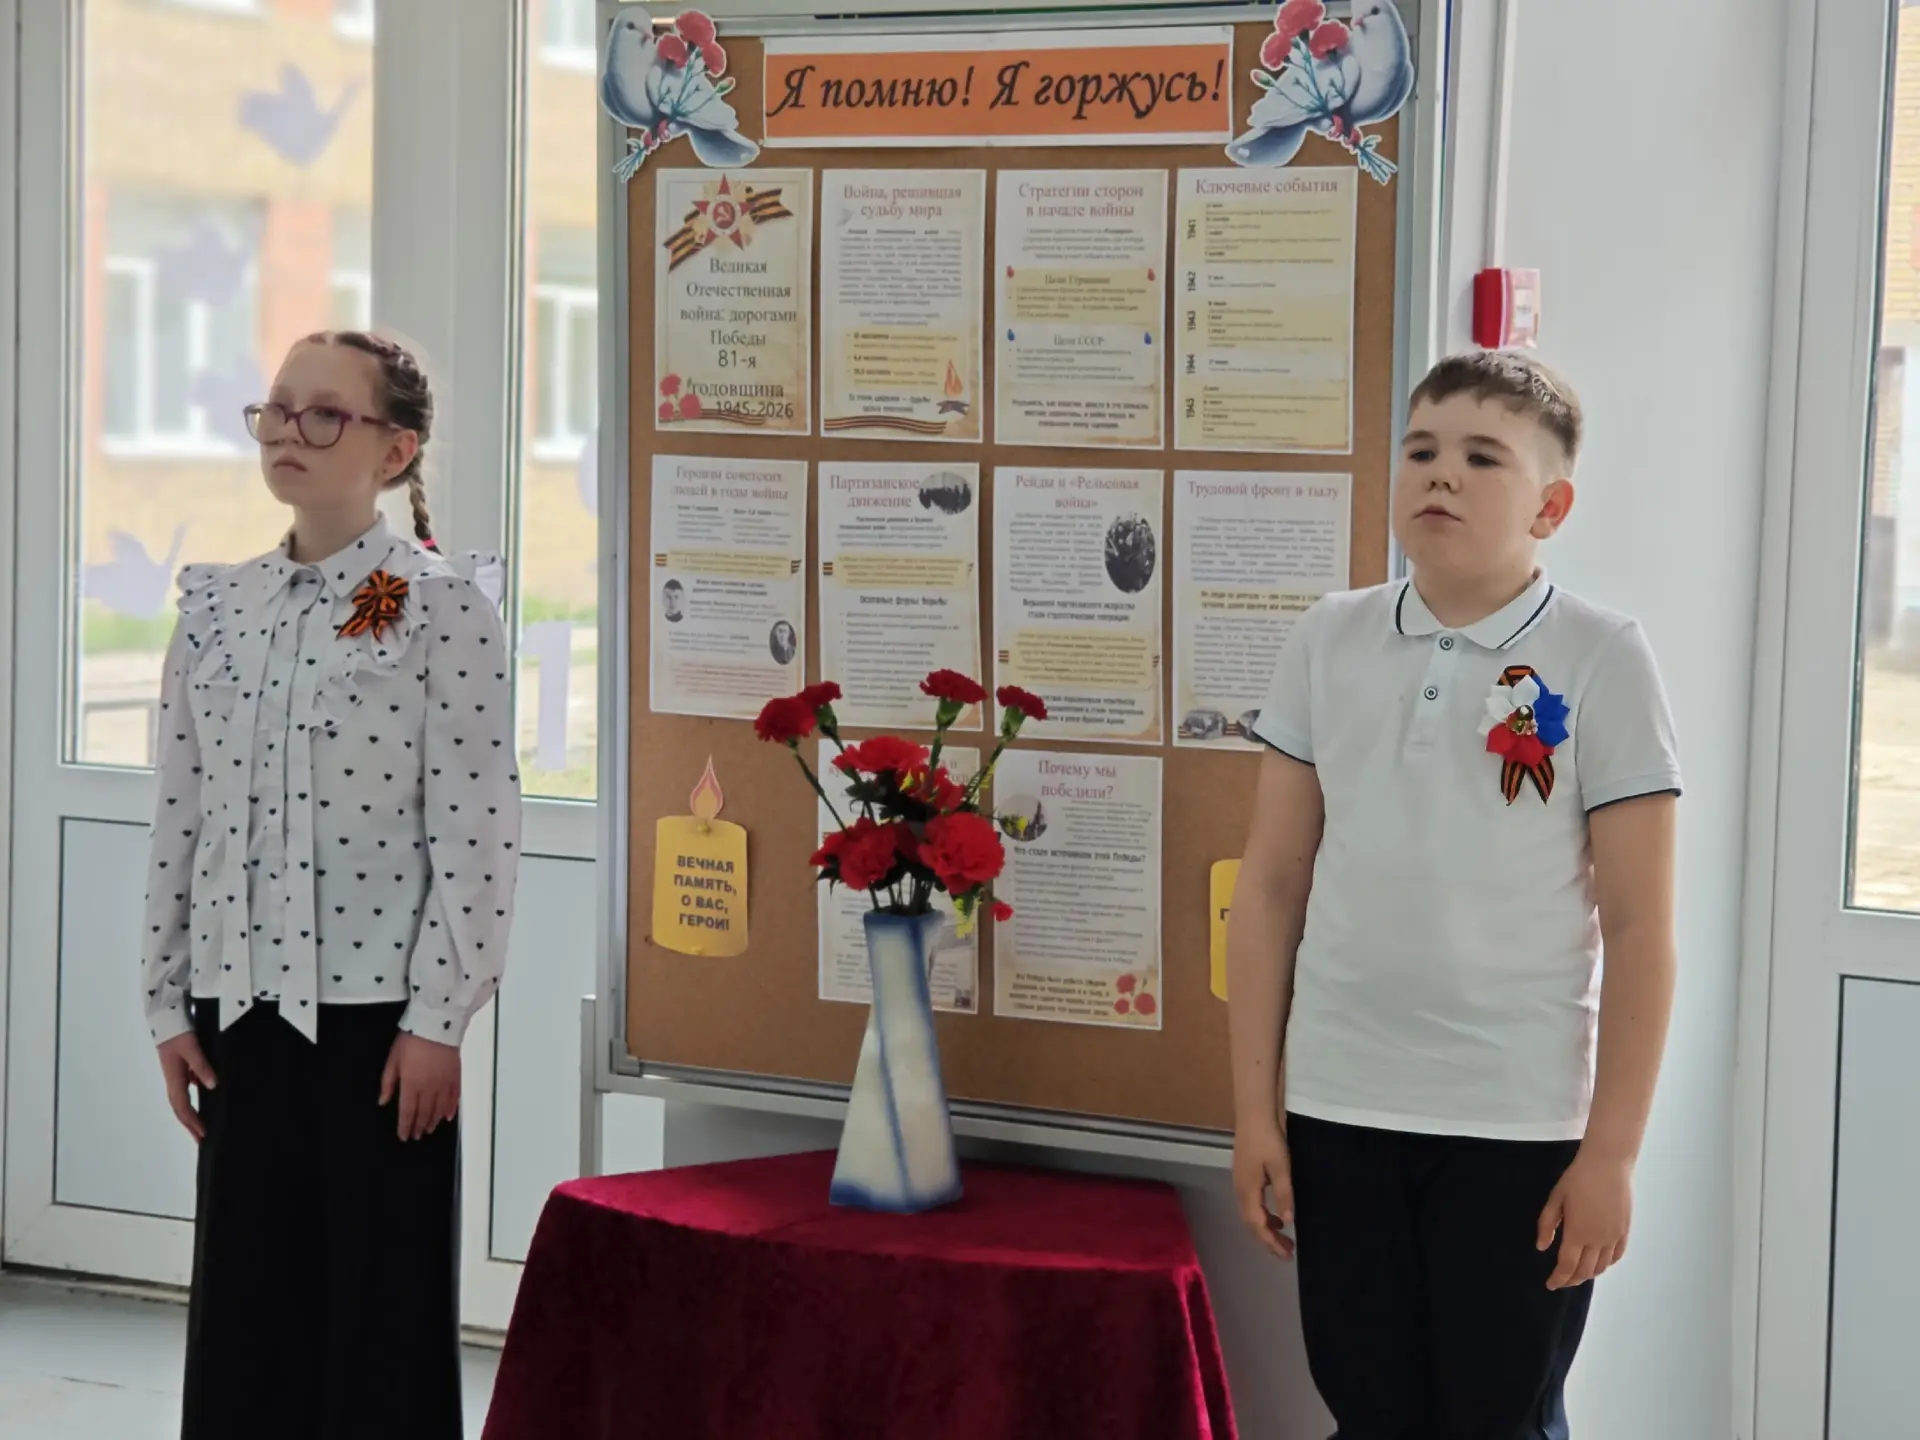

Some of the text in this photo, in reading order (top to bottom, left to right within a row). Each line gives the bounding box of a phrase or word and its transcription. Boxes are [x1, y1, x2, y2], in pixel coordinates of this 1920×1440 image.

[766, 58, 1224, 120] Я помню! Я горжусь!
[844, 184, 962, 204] Война, решившая
[1019, 184, 1143, 201] Стратегии сторон
[1195, 177, 1338, 194] Ключевые события
[861, 203, 943, 220] судьбу мира
[1027, 204, 1134, 218] в начале войны
[1187, 219, 1197, 239] 1941
[709, 258, 767, 274] Великая
[1187, 271, 1197, 292] 1942
[686, 283, 791, 299] Отечественная
[728, 310, 797, 325] дорогами
[1187, 310, 1196, 331] 1943
[710, 330, 766, 347] Победы
[718, 350, 756, 368] 81-я
[1186, 354, 1195, 374] 1944
[692, 382, 784, 399] годовщина
[716, 401, 794, 418] 1945-2026
[1186, 398, 1195, 418] 1945
[830, 475, 920, 492] Партизанское
[1016, 475, 1054, 490] Рейды
[1188, 481, 1247, 499] Трудовой
[1251, 482, 1290, 499] фронт
[1308, 487, 1339, 500] тылу
[847, 495, 912, 508] движение
[1038, 759, 1116, 779] Почему мы
[1041, 784, 1114, 800] победили?
[677, 855, 735, 874] ВЕЧНАЯ
[674, 874, 737, 896] ПАМЯТЬ,
[681, 895, 729, 914] О ВАС,
[679, 913, 730, 931] ГЕРОИ!
